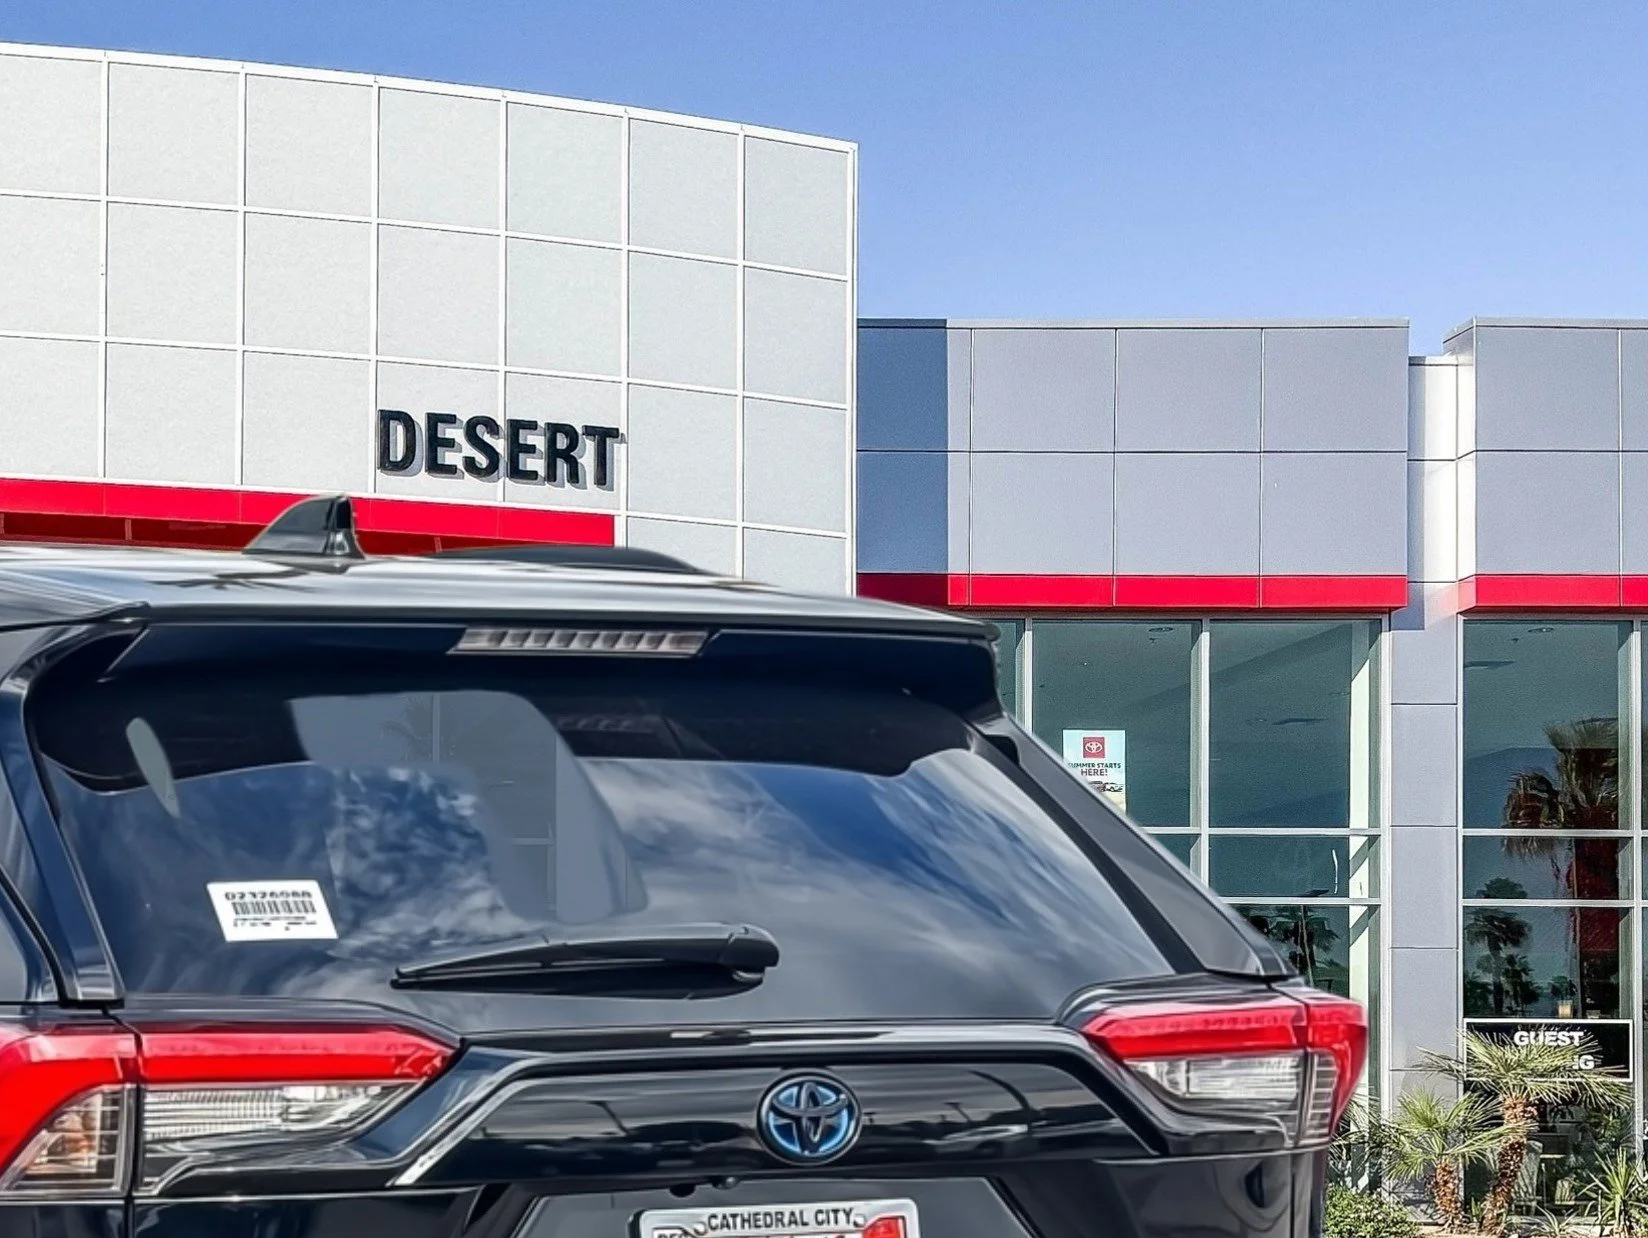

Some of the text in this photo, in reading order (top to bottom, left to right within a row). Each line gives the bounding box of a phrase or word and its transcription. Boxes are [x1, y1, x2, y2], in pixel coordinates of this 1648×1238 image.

[377, 409, 620, 486] DESERT
[1513, 1031, 1584, 1047] GUEST
[707, 1207, 854, 1231] CATHEDRAL CITY
